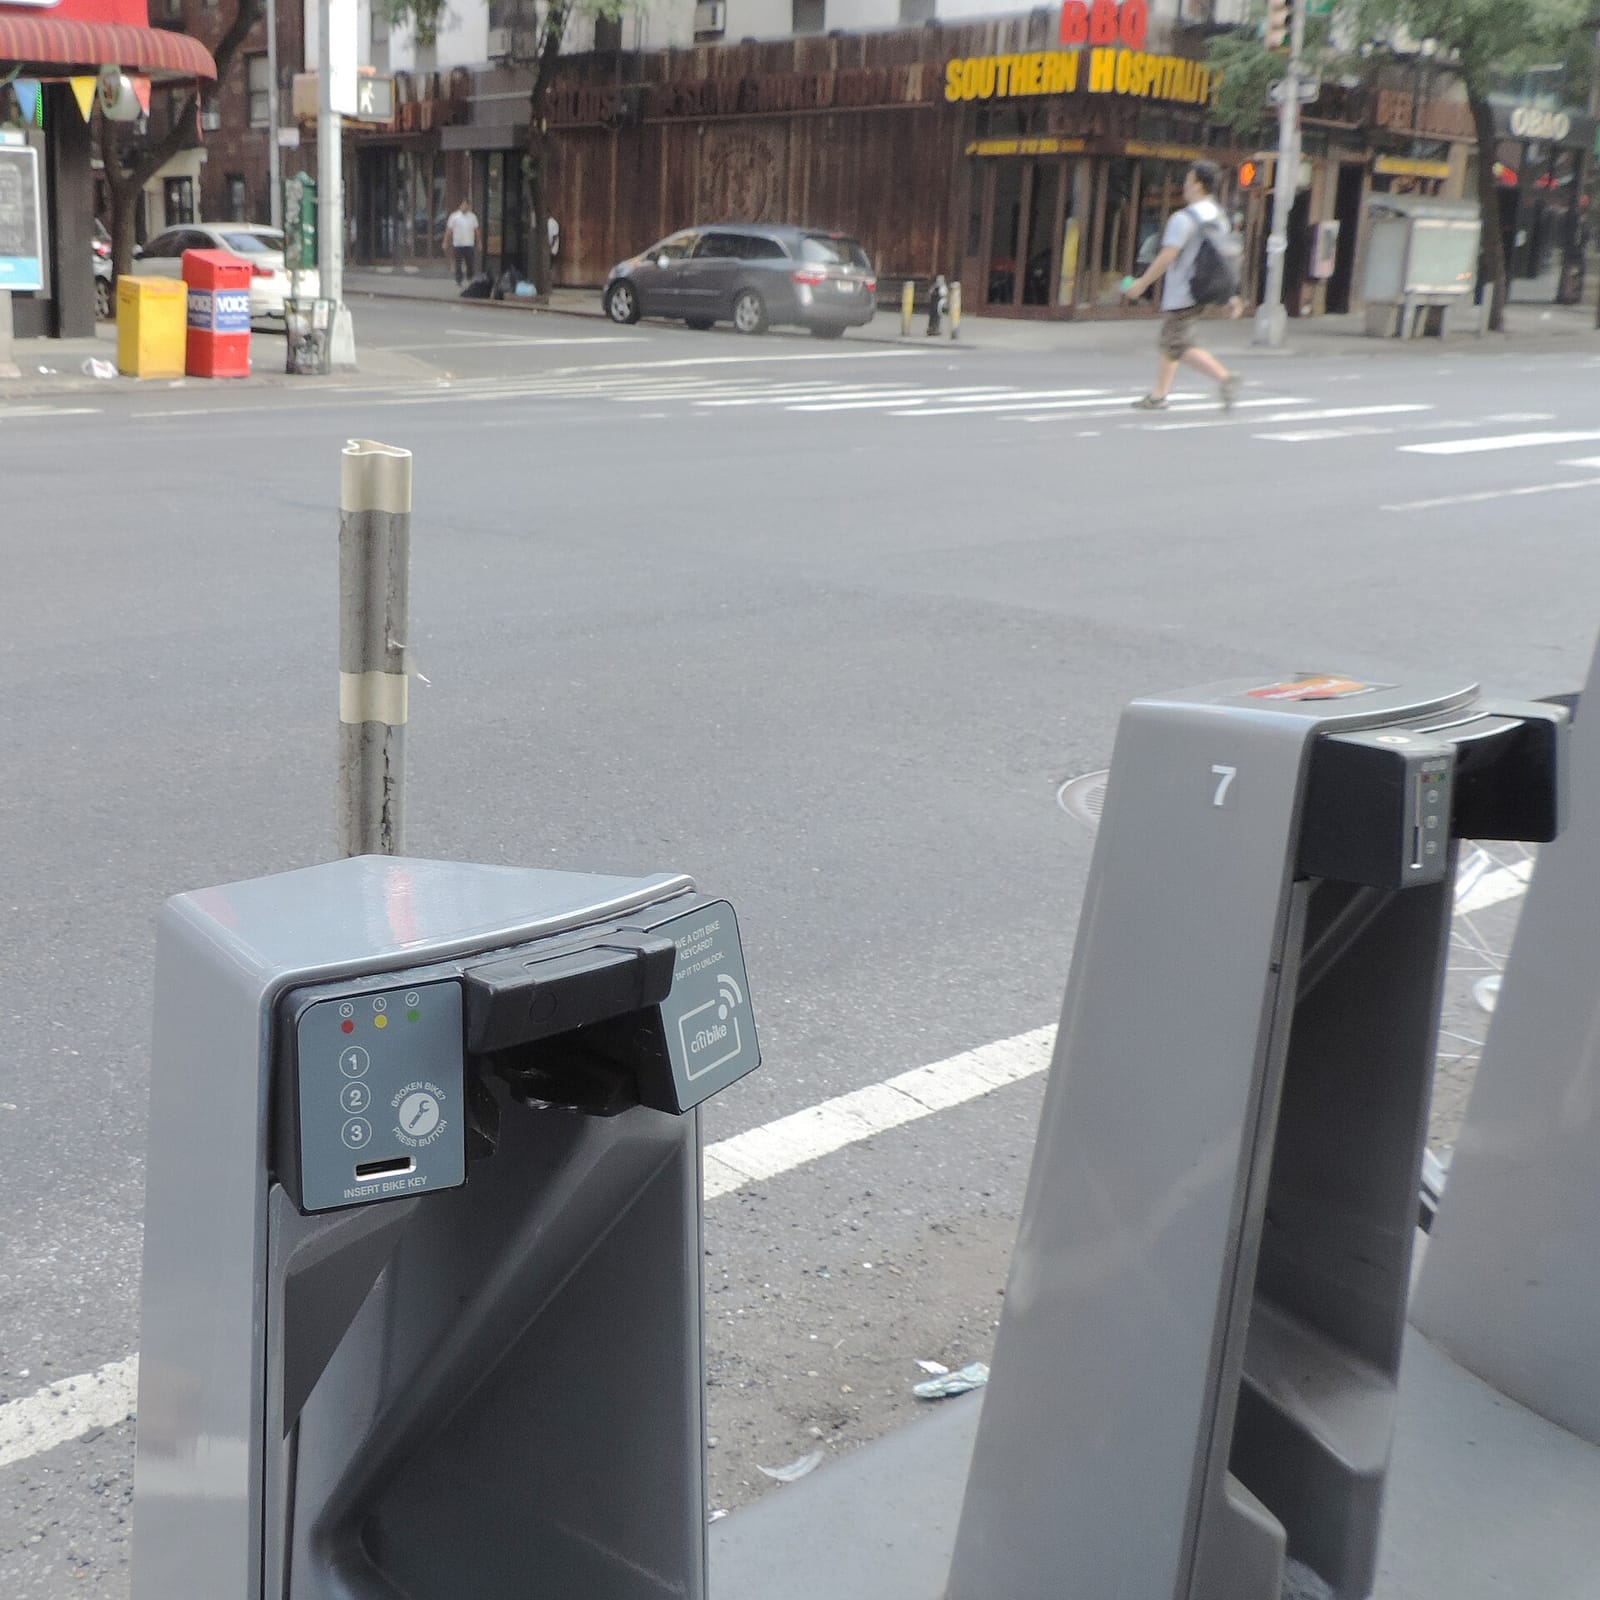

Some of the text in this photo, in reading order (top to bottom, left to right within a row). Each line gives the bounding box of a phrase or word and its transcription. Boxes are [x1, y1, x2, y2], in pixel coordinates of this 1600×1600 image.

[1059, 0, 1149, 51] BBQ
[945, 51, 1079, 102] SOUTHERN
[217, 296, 249, 312] VOICE
[1211, 764, 1236, 806] 7
[705, 920, 720, 935] BIKE
[350, 1090, 362, 1106] 2
[391, 1081, 447, 1107] BROKEN BIKE?
[351, 1125, 362, 1141] 3
[392, 1119, 448, 1147] PRESS BUTTON
[343, 1176, 427, 1199] INSERT BIKE KEY
